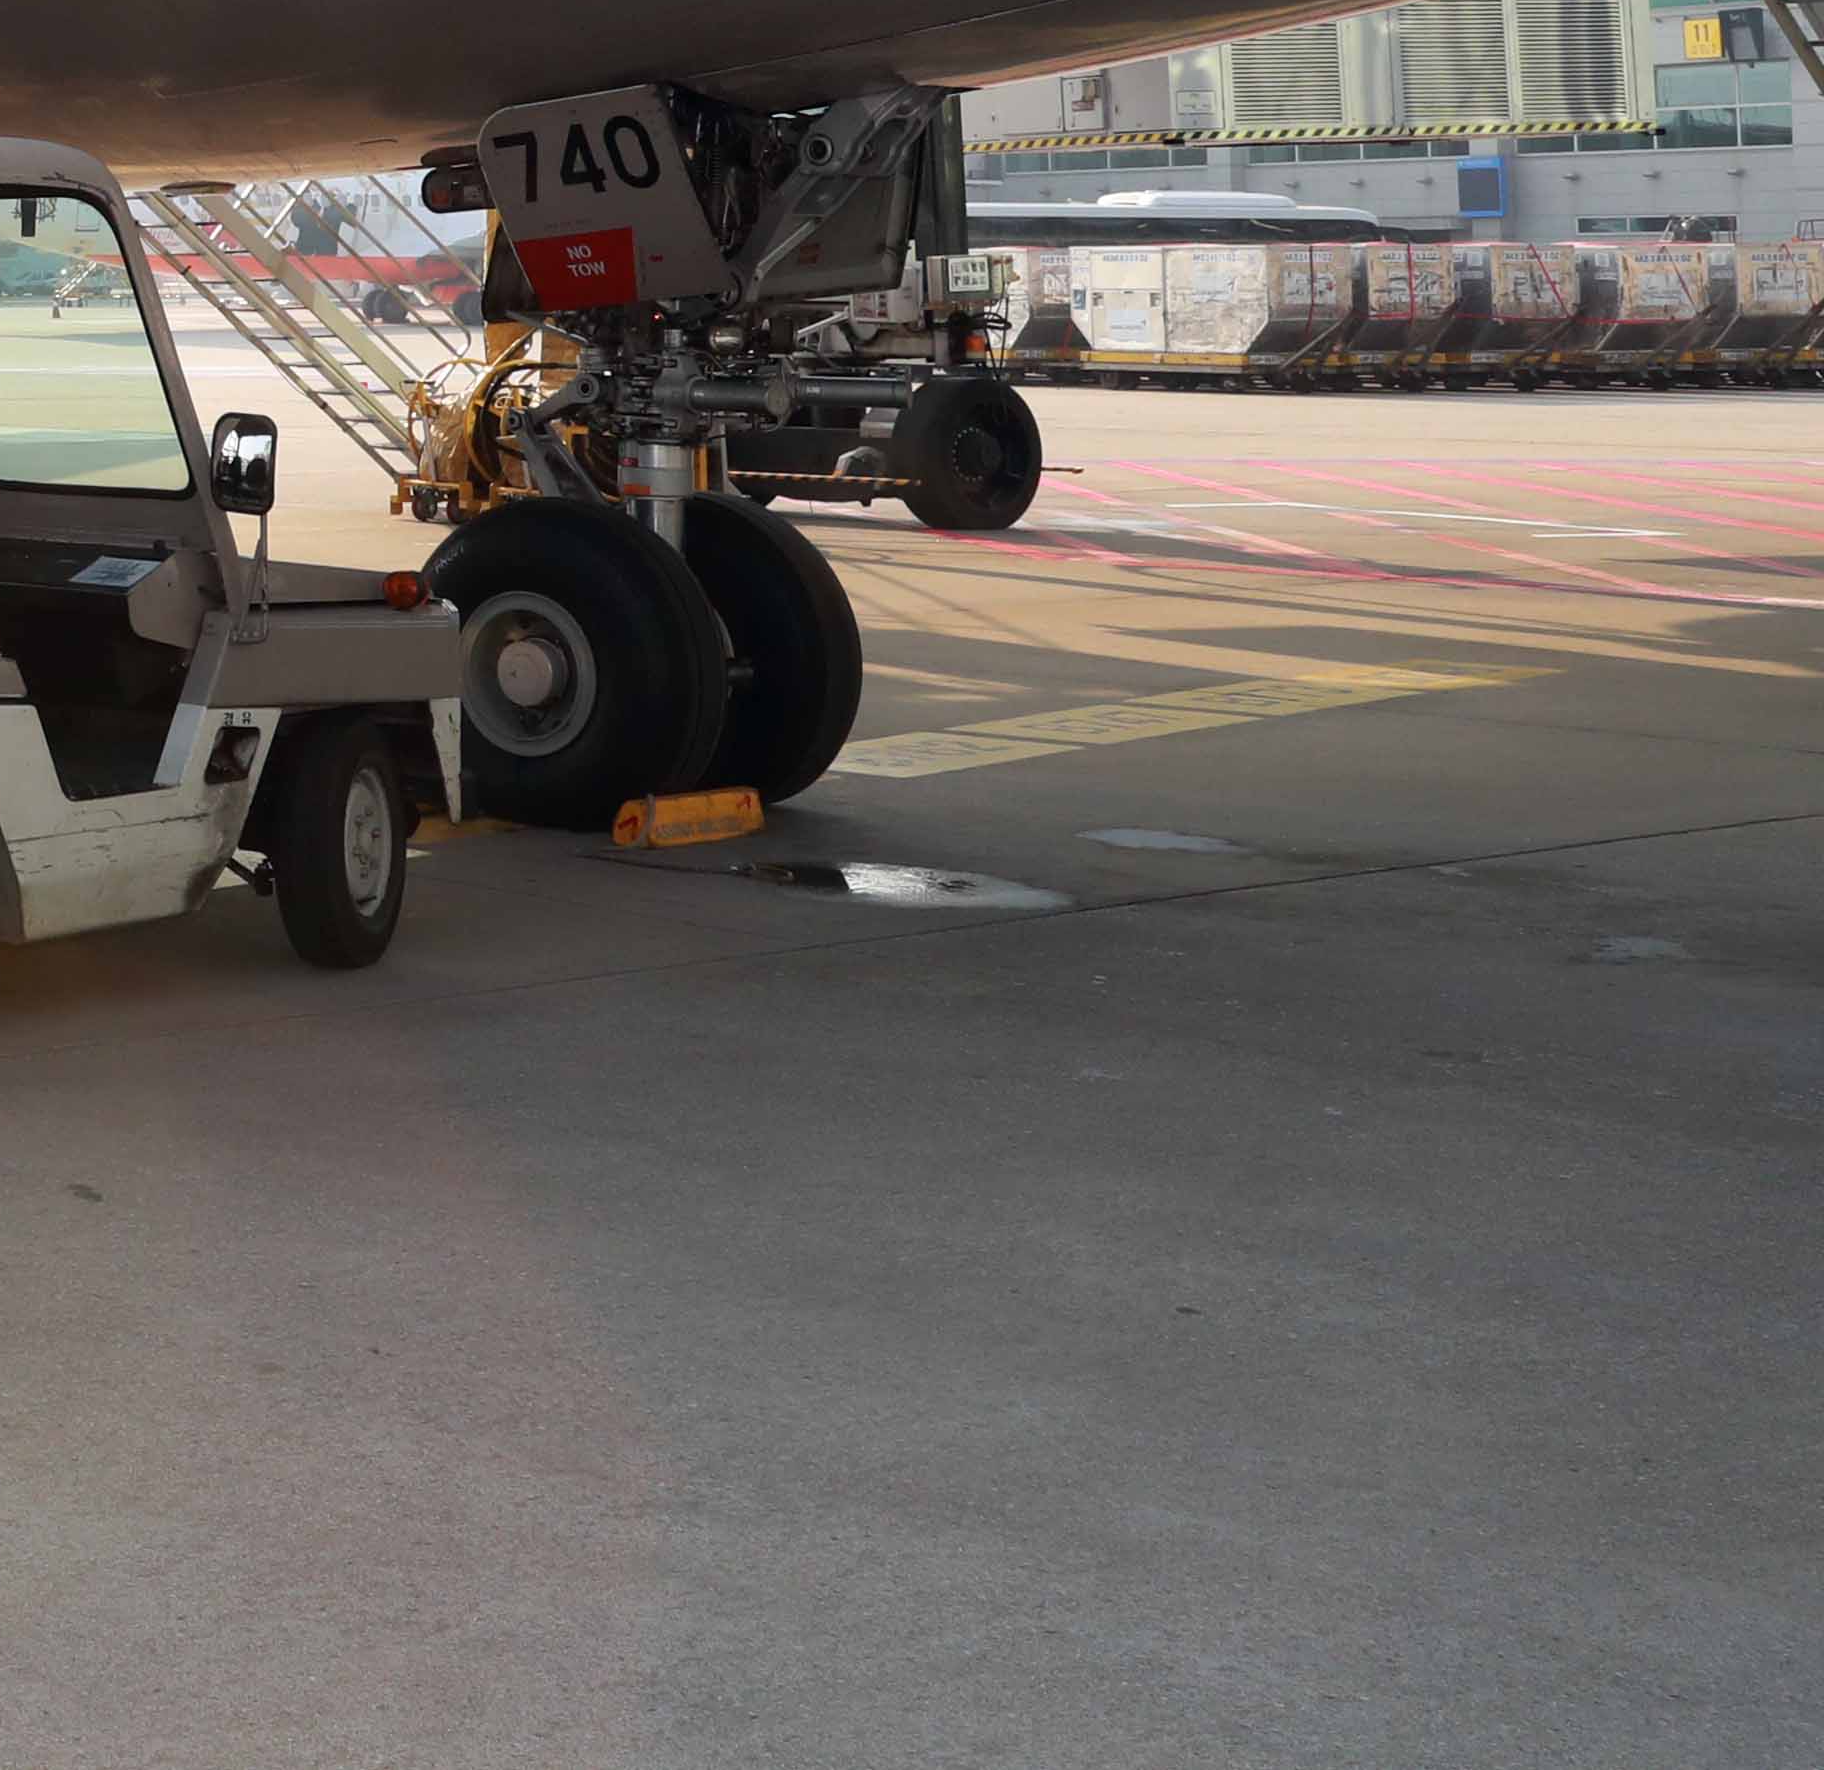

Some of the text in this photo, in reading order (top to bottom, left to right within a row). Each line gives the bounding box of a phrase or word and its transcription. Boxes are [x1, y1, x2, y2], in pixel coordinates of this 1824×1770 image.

[1694, 23, 1709, 43] 11
[493, 115, 661, 203] 740
[566, 245, 592, 261] NO
[567, 261, 607, 278] TOW
